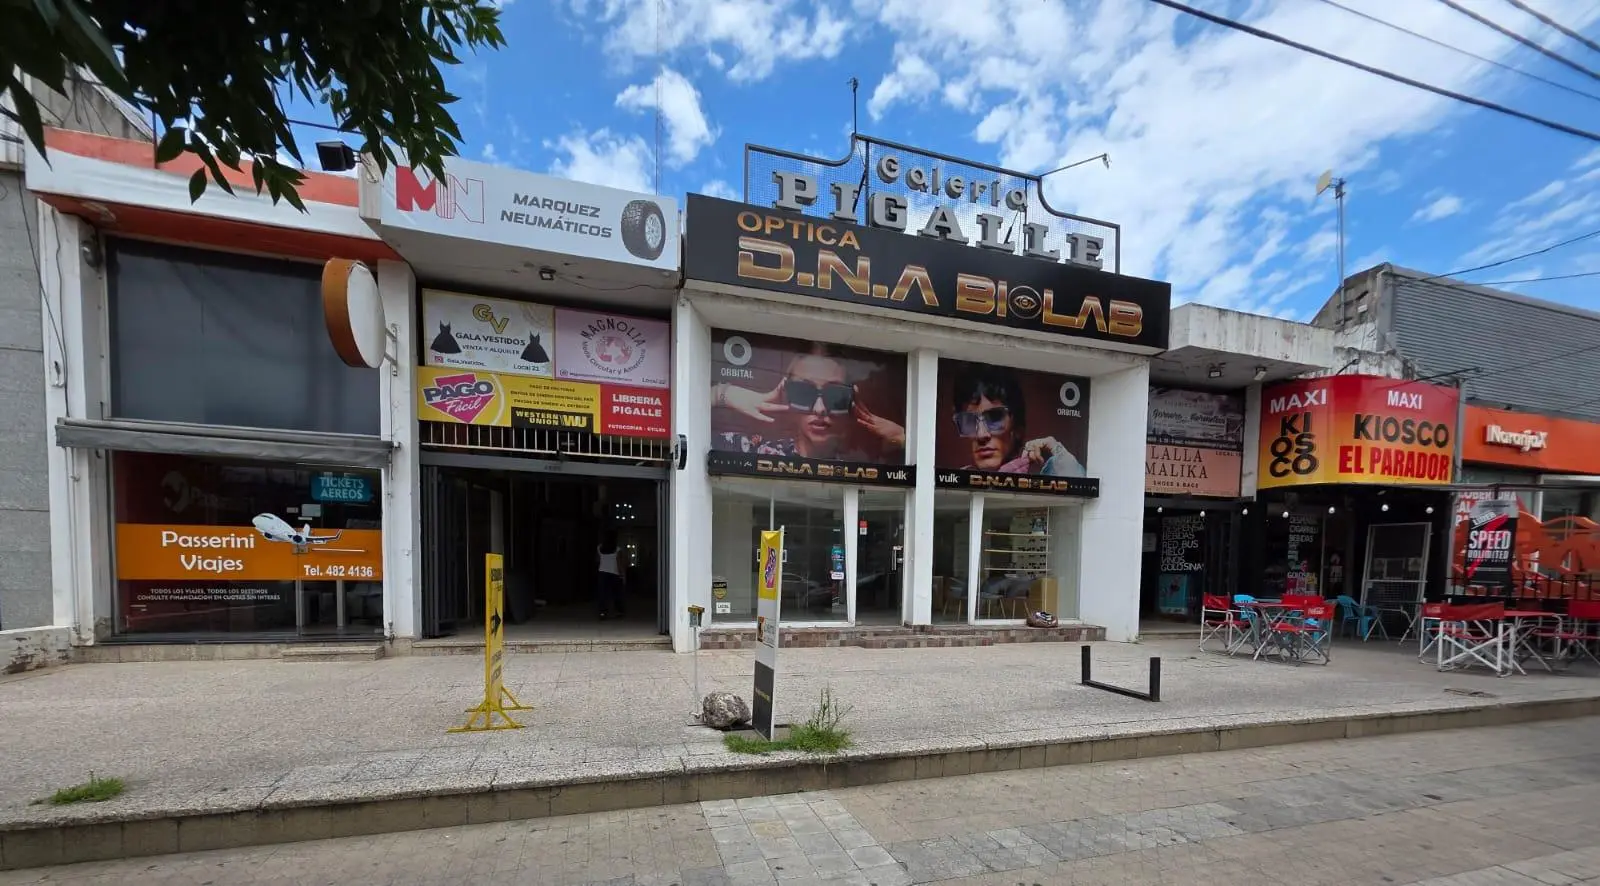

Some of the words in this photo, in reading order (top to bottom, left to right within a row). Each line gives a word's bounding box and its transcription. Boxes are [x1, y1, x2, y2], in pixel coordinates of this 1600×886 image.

[513, 193, 601, 218] MARQUEZ
[500, 209, 612, 238] NEUMÁTICOS
[772, 170, 1104, 270] PIGALLE
[736, 210, 860, 250] OPTICA
[737, 236, 939, 307] D.N.A
[956, 272, 1143, 338] BIOLAB
[472, 303, 510, 335] GV
[455, 332, 481, 342] GALA
[482, 335, 526, 346] VESTIDOS
[580, 318, 646, 348] MAGNOLIA
[462, 344, 484, 352] VENTA
[490, 347, 520, 355] ALQUILER
[513, 363, 531, 371] Local
[721, 367, 754, 379] ORBITAL
[423, 381, 494, 403] PAGO
[612, 394, 662, 406] LIBRERIA
[1269, 388, 1327, 414] MAXI
[1387, 390, 1423, 410] MAXI
[445, 397, 482, 413] Fácil
[612, 405, 662, 417] PIGALLE
[1057, 408, 1082, 418] ORBITAL
[515, 410, 559, 420] WESTERN
[529, 418, 559, 426] UNION
[1353, 413, 1450, 448] KIOSCO
[1151, 446, 1203, 462] LALLA
[1338, 445, 1364, 474] EL
[1369, 447, 1450, 480] PARADOR
[817, 463, 879, 479] BIOLAB
[886, 469, 908, 481] vulk
[938, 474, 960, 484] vulk
[1145, 461, 1209, 479] MALIKA
[318, 476, 365, 489] TICKETS
[161, 530, 255, 549] Passerini
[1469, 530, 1511, 550] SPEED
[180, 555, 244, 573] Viajes
[304, 565, 324, 577] Tel.
[326, 565, 346, 577] 482
[348, 566, 373, 578] 4136
